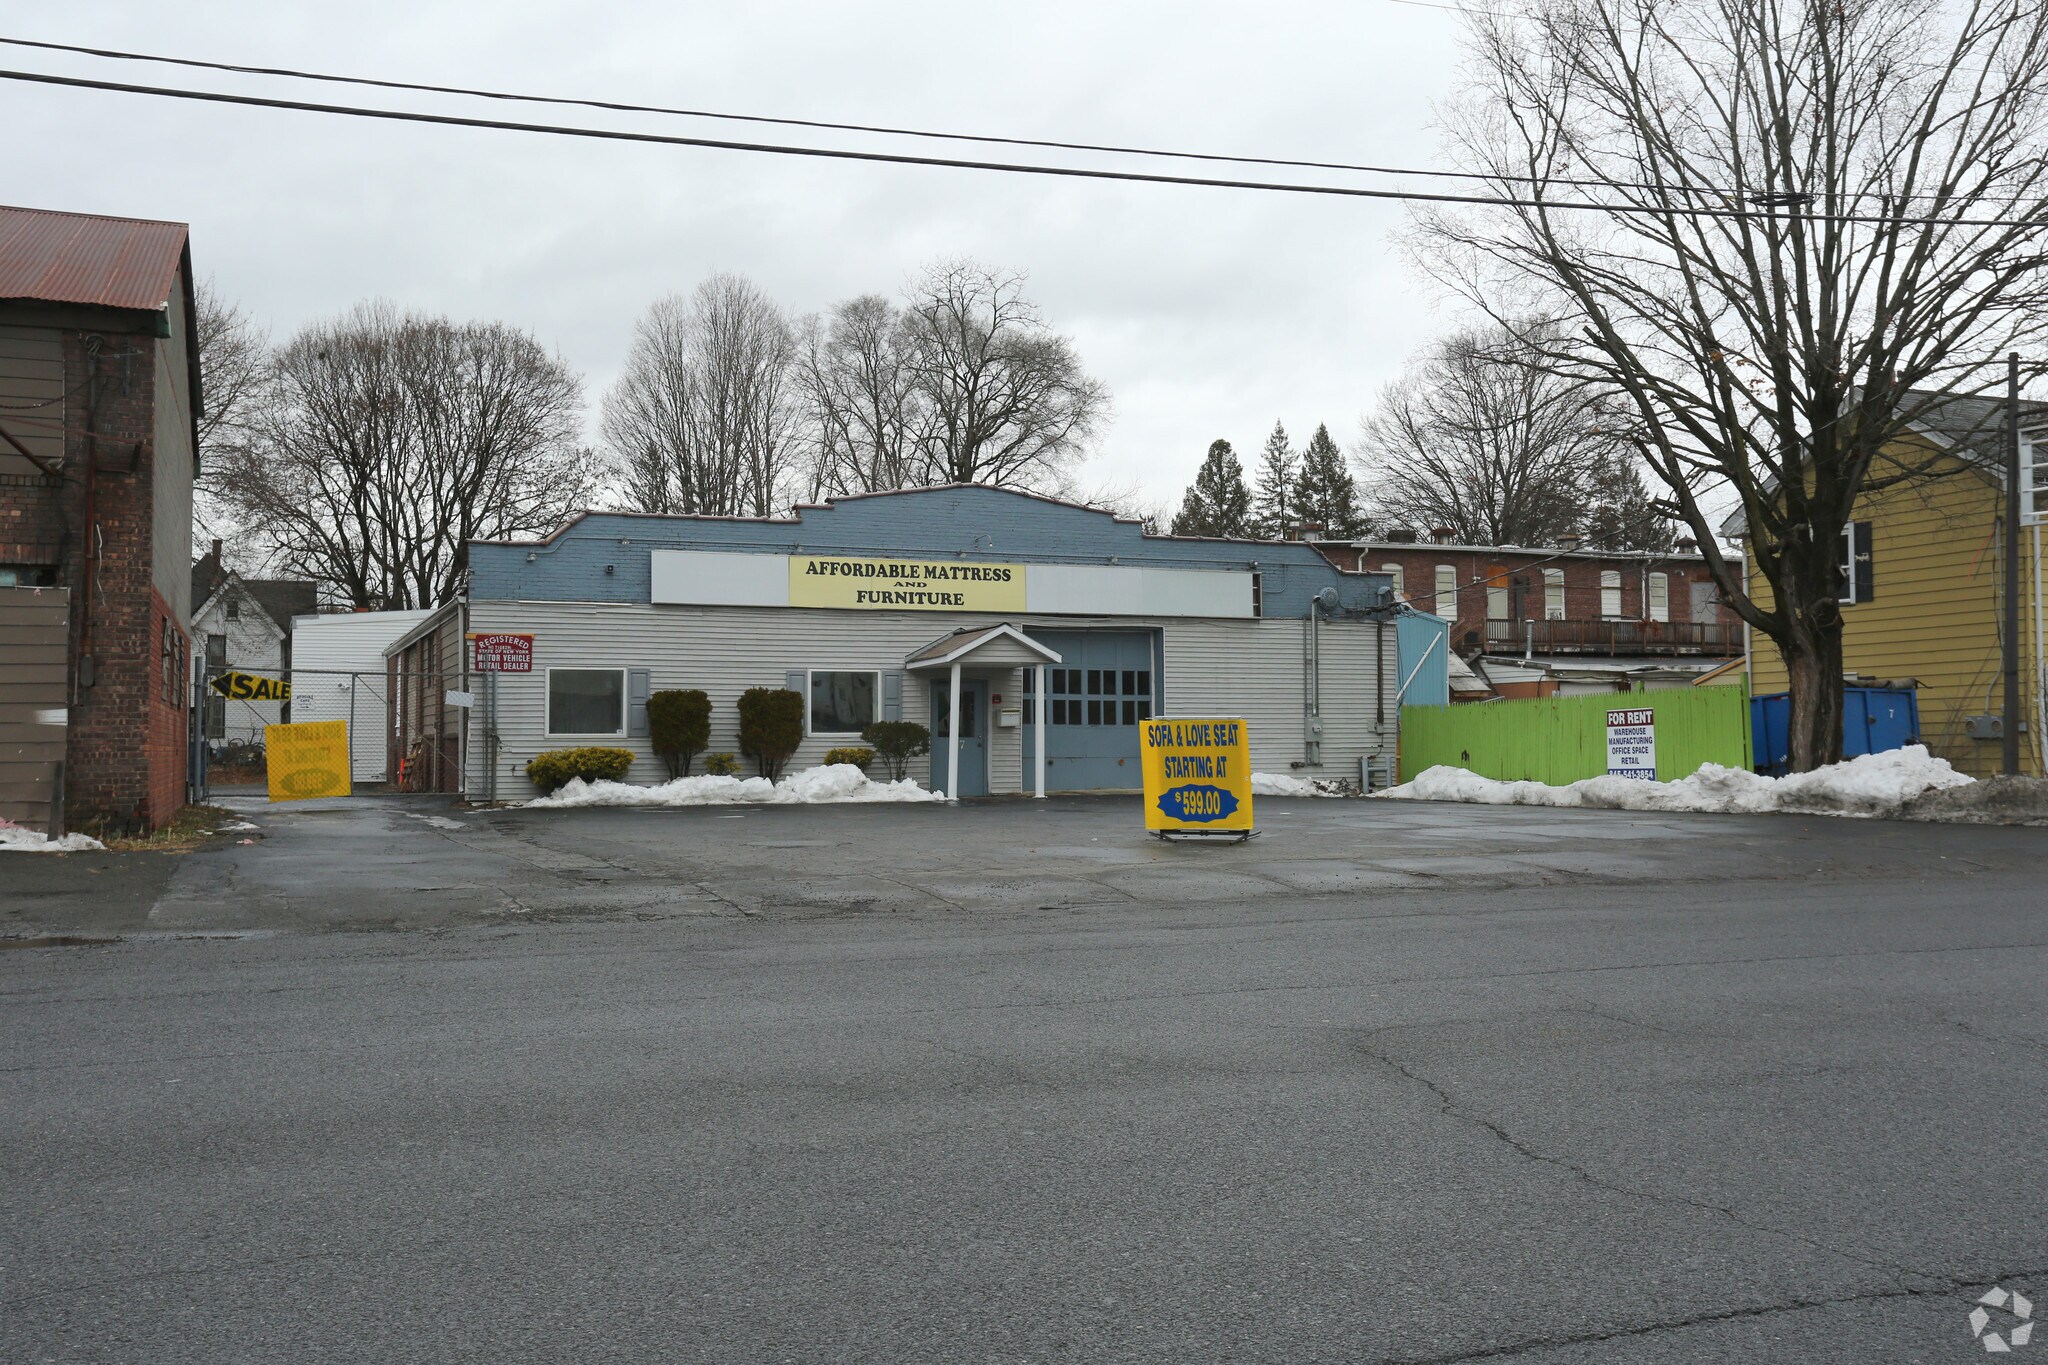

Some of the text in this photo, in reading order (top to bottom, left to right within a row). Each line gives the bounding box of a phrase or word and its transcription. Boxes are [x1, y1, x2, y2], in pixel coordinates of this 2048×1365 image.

[805, 560, 1011, 582] AFFORDABLE MATTRESS
[856, 590, 965, 606] FURNITURE
[478, 635, 529, 649] REGISTERED
[503, 654, 531, 662] VEHICLE
[478, 662, 529, 670] RETAIL DEALER
[232, 674, 290, 700] SALE
[1608, 711, 1652, 725] FOR RENT
[1888, 709, 1895, 719] 7
[1148, 723, 1239, 747] SOFA & LOVE SEAT
[1609, 737, 1652, 745] MANUFACTURING
[959, 740, 965, 750] 7
[1632, 746, 1648, 754] SPACE
[1164, 756, 1227, 778] STARTING AT
[1621, 757, 1640, 765] RETAIL
[1174, 790, 1221, 815] $599.00
